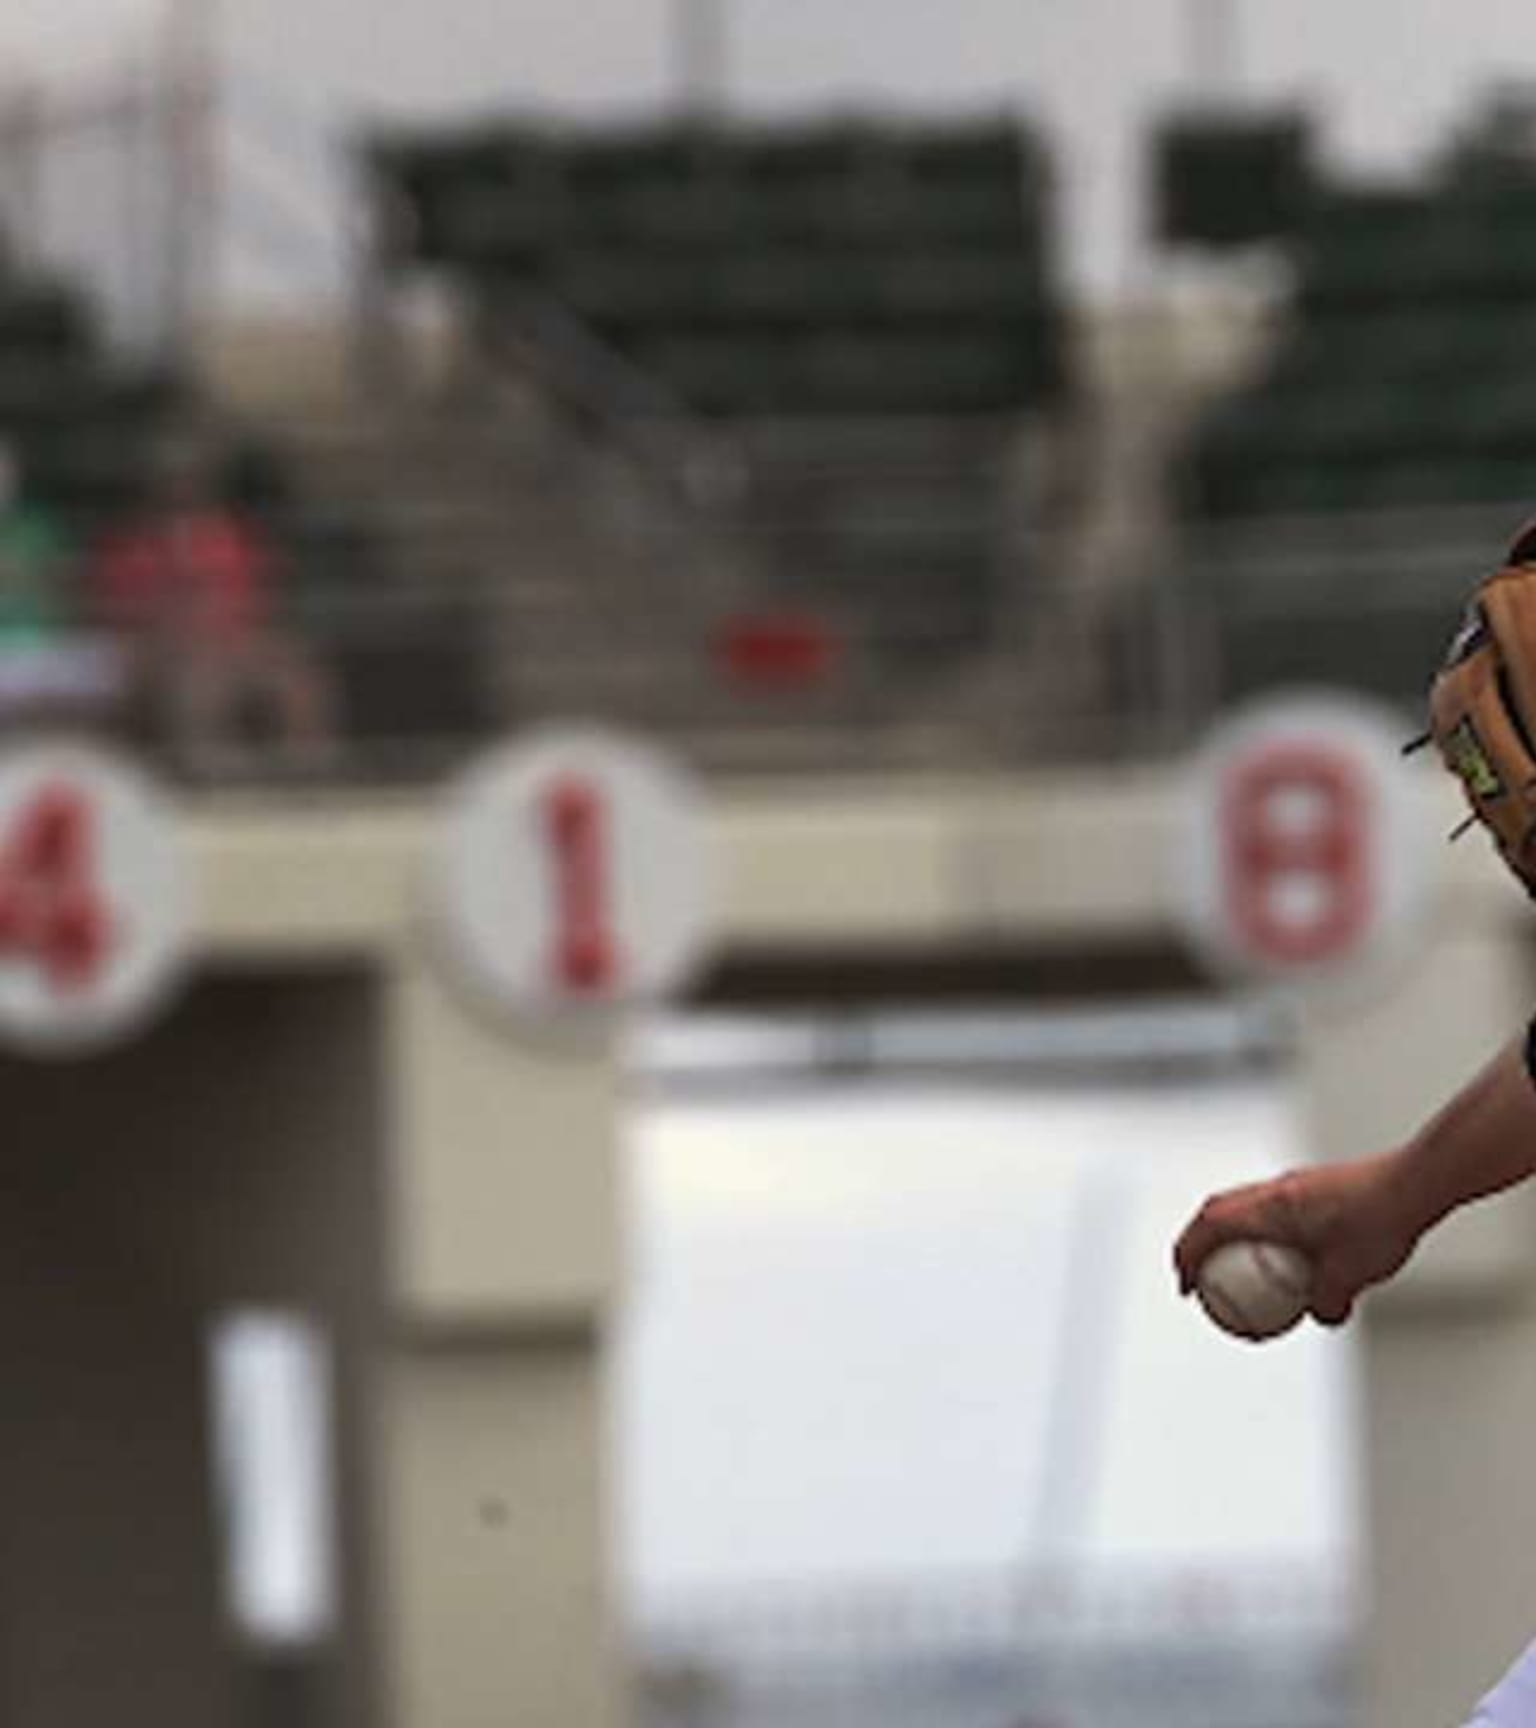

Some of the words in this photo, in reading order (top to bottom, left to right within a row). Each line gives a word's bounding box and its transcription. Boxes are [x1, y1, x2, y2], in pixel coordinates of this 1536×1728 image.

[0, 778, 116, 1000] 4
[534, 768, 624, 1002] 1
[1216, 738, 1382, 966] 8
